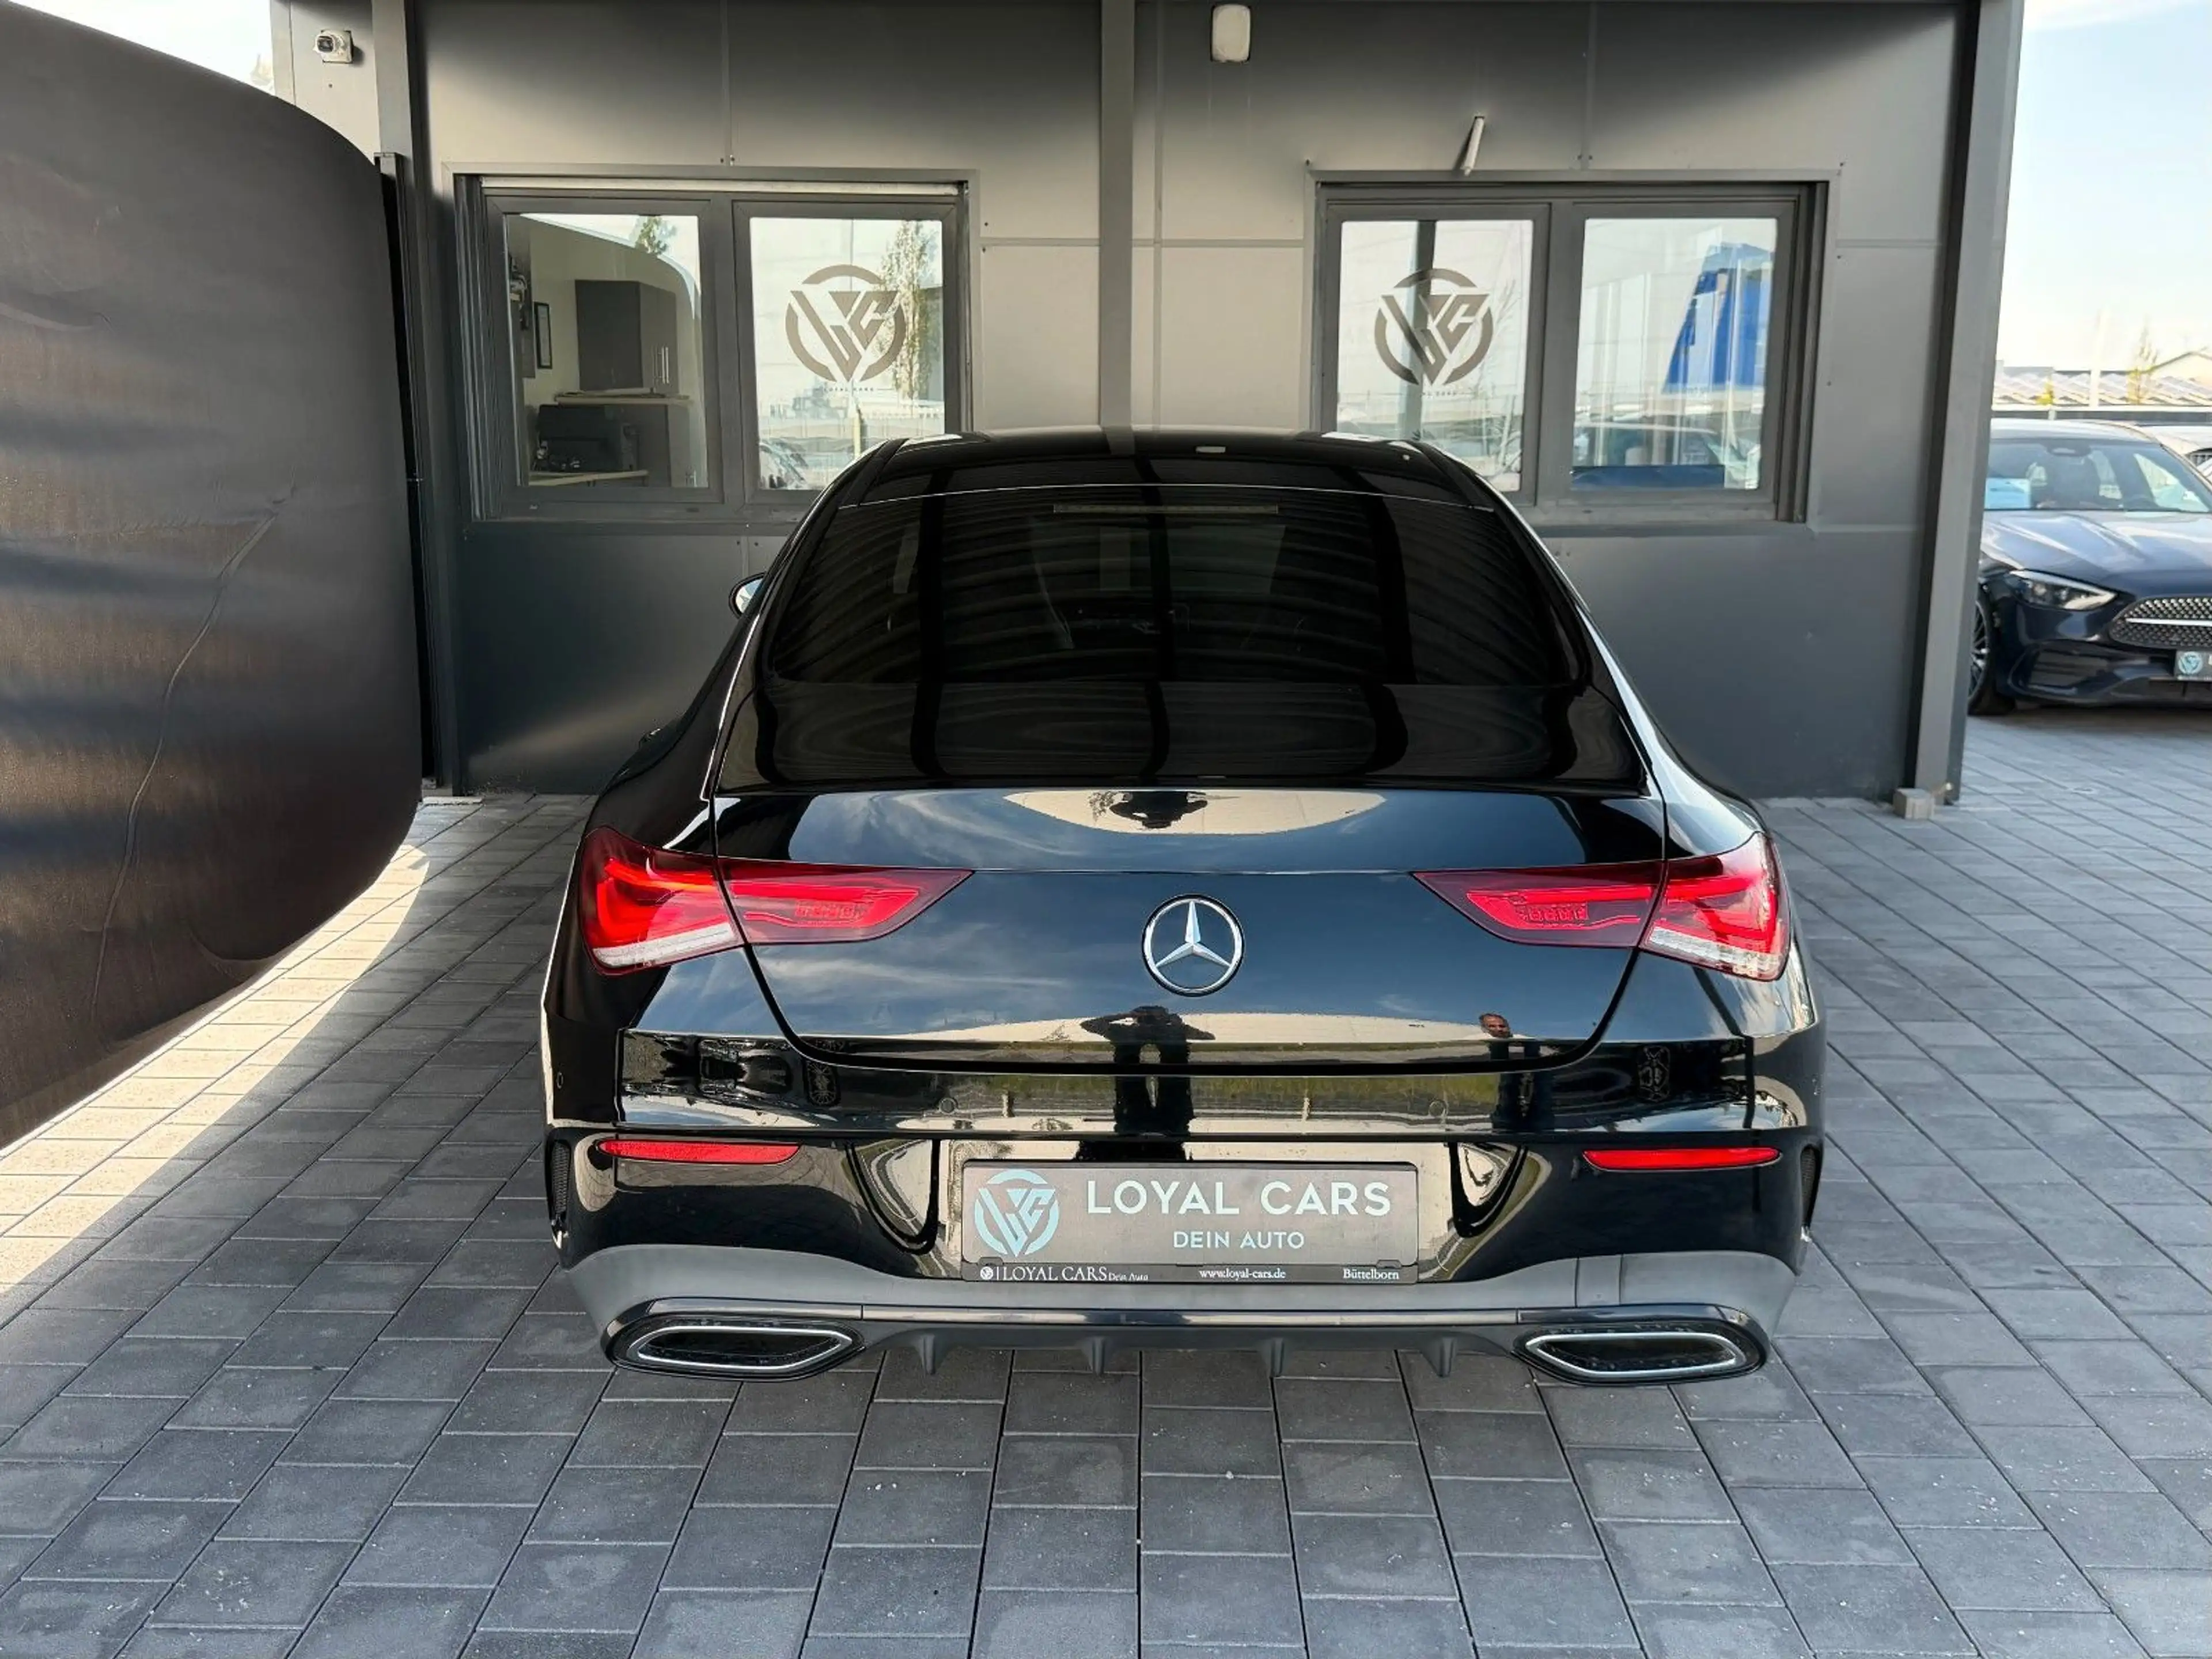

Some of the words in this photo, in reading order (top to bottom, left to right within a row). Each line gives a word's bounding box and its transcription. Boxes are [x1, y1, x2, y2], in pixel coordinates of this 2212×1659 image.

[1088, 1180, 1240, 1215] LOYAL
[1260, 1180, 1392, 1217] CARS
[1173, 1230, 1230, 1249] DEIN
[1240, 1231, 1305, 1249] AUTO
[1003, 1267, 1059, 1281] LOYAL
[1061, 1267, 1108, 1281] CARS
[1199, 1268, 1286, 1281] www.loyal-cars.de
[1342, 1268, 1400, 1280] Büttelborn
